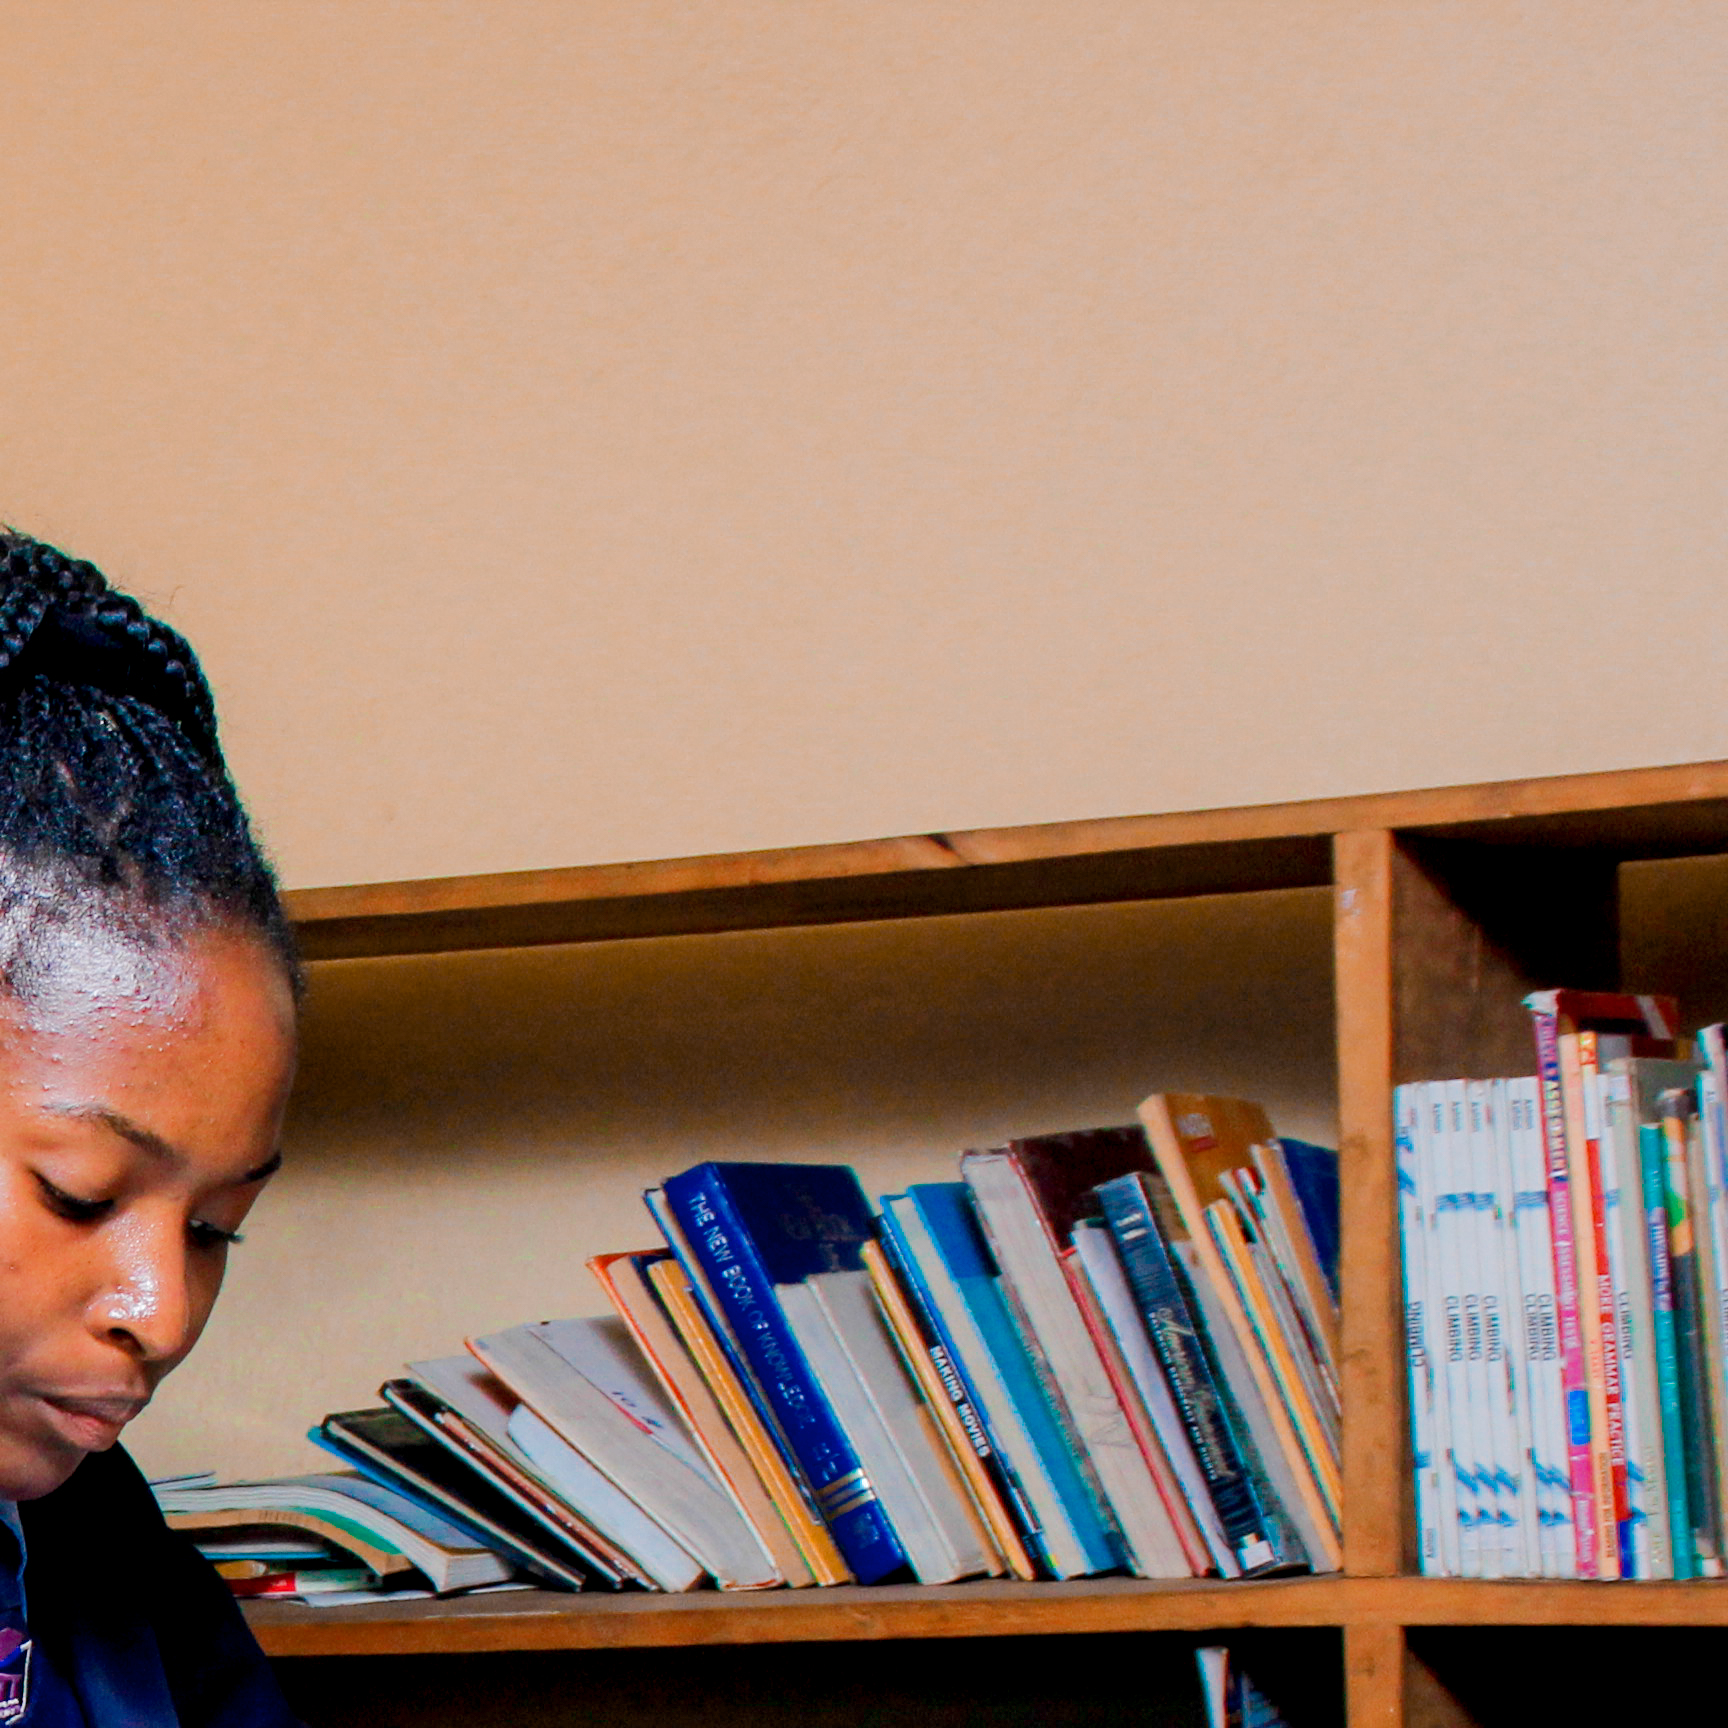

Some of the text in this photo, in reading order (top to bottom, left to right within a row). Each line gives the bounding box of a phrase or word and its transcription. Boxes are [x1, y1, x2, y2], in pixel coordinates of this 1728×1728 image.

[689, 1192, 815, 1427] THE NEW BOOK OF KNOWLEDGE
[1446, 1295, 1464, 1363] CLIMBING
[1465, 1294, 1482, 1362] CLIMBING
[1484, 1295, 1501, 1362] CLIMBING
[1525, 1293, 1540, 1361] CLIMBING
[1539, 1293, 1556, 1362] CLIMBING
[1619, 1291, 1633, 1360] CLIMBING
[930, 1345, 991, 1457] MAKING MOVIES
[1598, 1275, 1625, 1466] MORE GRAMMAR PRACTICE
[1191, 1425, 1203, 1445] AND
[1200, 1445, 1217, 1481] RIGHTS
